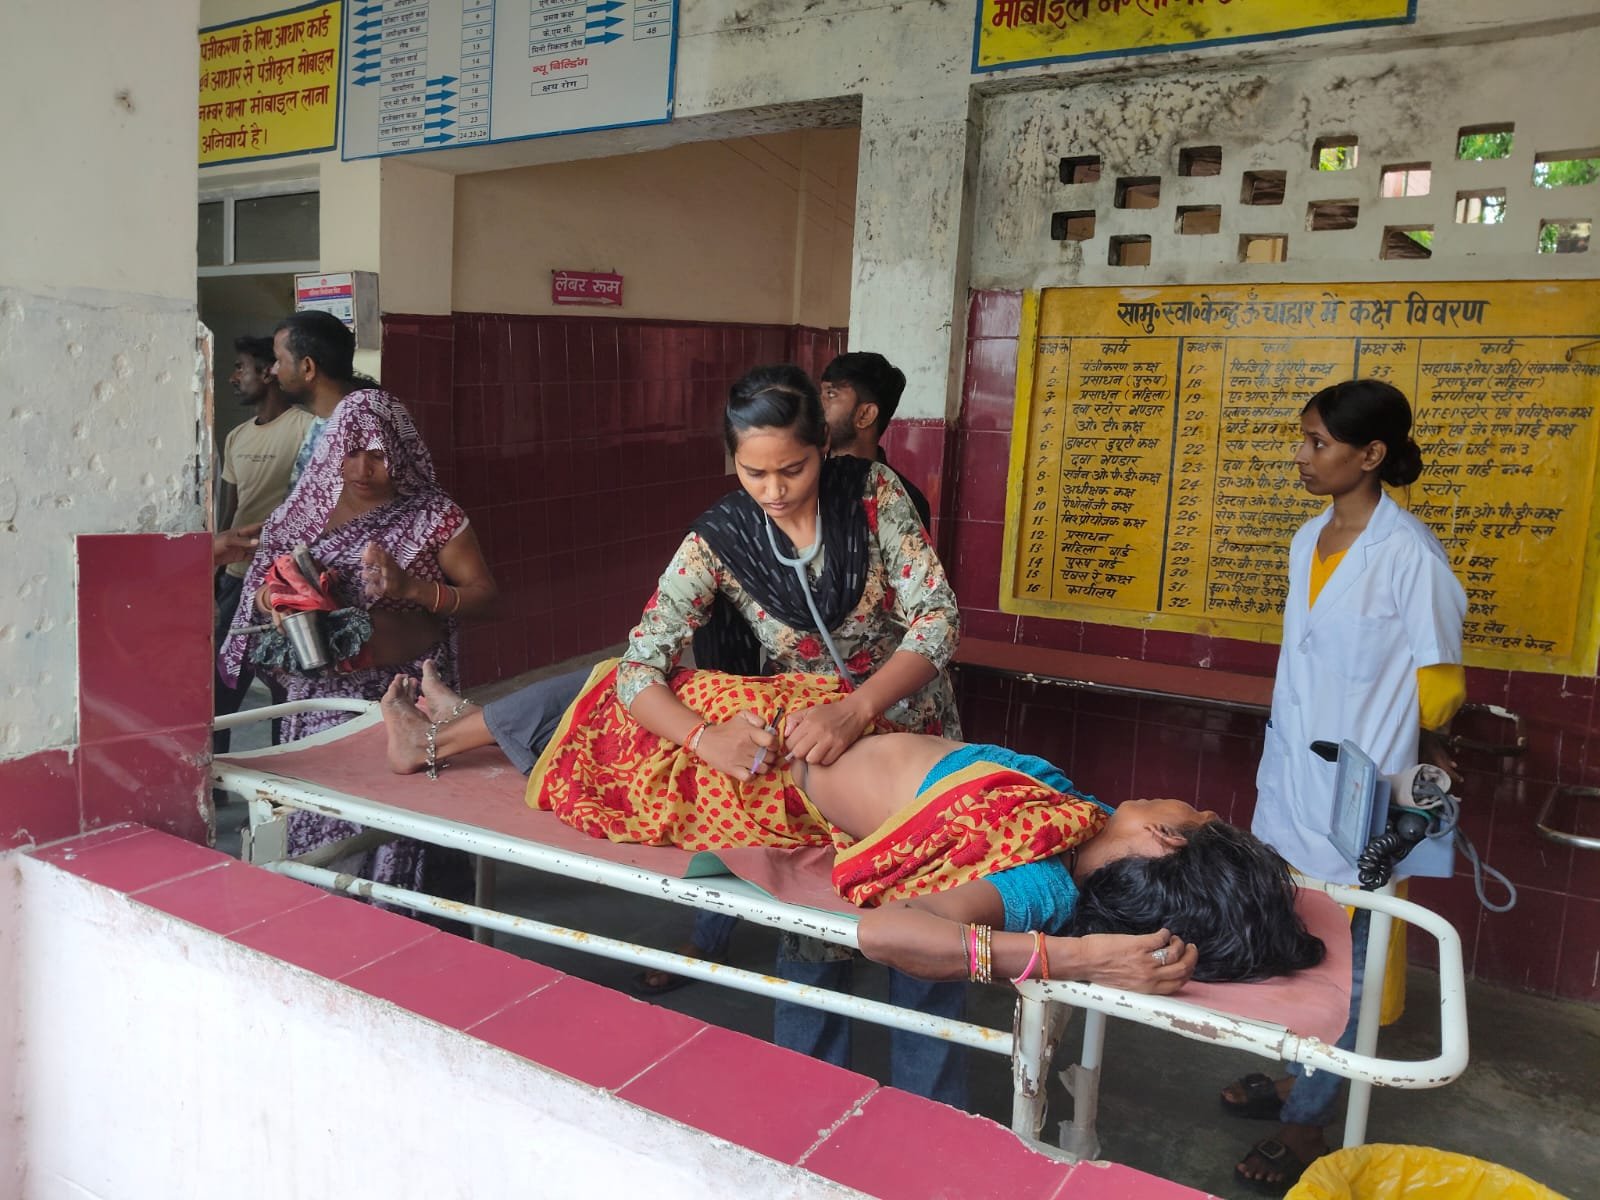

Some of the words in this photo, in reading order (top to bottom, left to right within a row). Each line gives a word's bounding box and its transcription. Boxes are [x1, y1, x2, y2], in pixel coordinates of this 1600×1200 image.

[242, 30, 253, 53] के
[254, 26, 273, 51] लिए
[275, 21, 305, 49] आधार
[307, 9, 332, 38] कार्ड
[211, 66, 242, 91] आधार
[243, 60, 255, 86] से
[257, 56, 295, 85] पंजीकृत
[298, 48, 335, 75] मोबाइल
[225, 98, 248, 119] वाला
[250, 90, 300, 115] मोबाइल
[301, 85, 331, 110] लाना
[202, 124, 249, 153] अनिवार्य
[555, 272, 588, 292] लेबर
[592, 280, 621, 295] रूम
[1321, 292, 1346, 323] में
[1350, 299, 1402, 330] कक्ष
[1405, 291, 1491, 328] विवरण
[1101, 338, 1131, 355] कार्य
[1480, 338, 1525, 355] कार्य
[1080, 360, 1128, 372] पंजीकरण
[1132, 362, 1162, 372] कक्ष
[1080, 375, 1124, 387] प्रसाधन
[1432, 377, 1487, 389] प्रसाधन
[1080, 390, 1122, 401] प्रसाधन
[1072, 403, 1092, 415] दवा
[1094, 400, 1126, 416] स्टोर
[1122, 421, 1146, 433] कक्ष
[1136, 438, 1161, 450] कक्ष
[1070, 454, 1097, 466] दवा
[1466, 458, 1499, 478] वार्ड
[1063, 482, 1113, 496] अधीक्षक
[1113, 487, 1136, 498] कक्ष
[1421, 480, 1467, 497] स्टोर
[1111, 502, 1135, 514] कक्ष
[1410, 500, 1453, 518] महिला
[1123, 519, 1148, 530] कक्ष
[1064, 529, 1114, 544] प्रसाधन
[1529, 525, 1556, 540] रूम
[1061, 541, 1104, 555] महिला
[1109, 543, 1137, 557] वार्ड
[1097, 556, 1126, 570] वार्ड
[1468, 556, 1499, 570] कक्ष
[1105, 573, 1136, 585] कक्ष
[1467, 571, 1497, 583] रूम
[1066, 583, 1118, 600] कार्यालय
[1466, 588, 1497, 601] कक्ष
[1468, 602, 1500, 616] कक्ष
